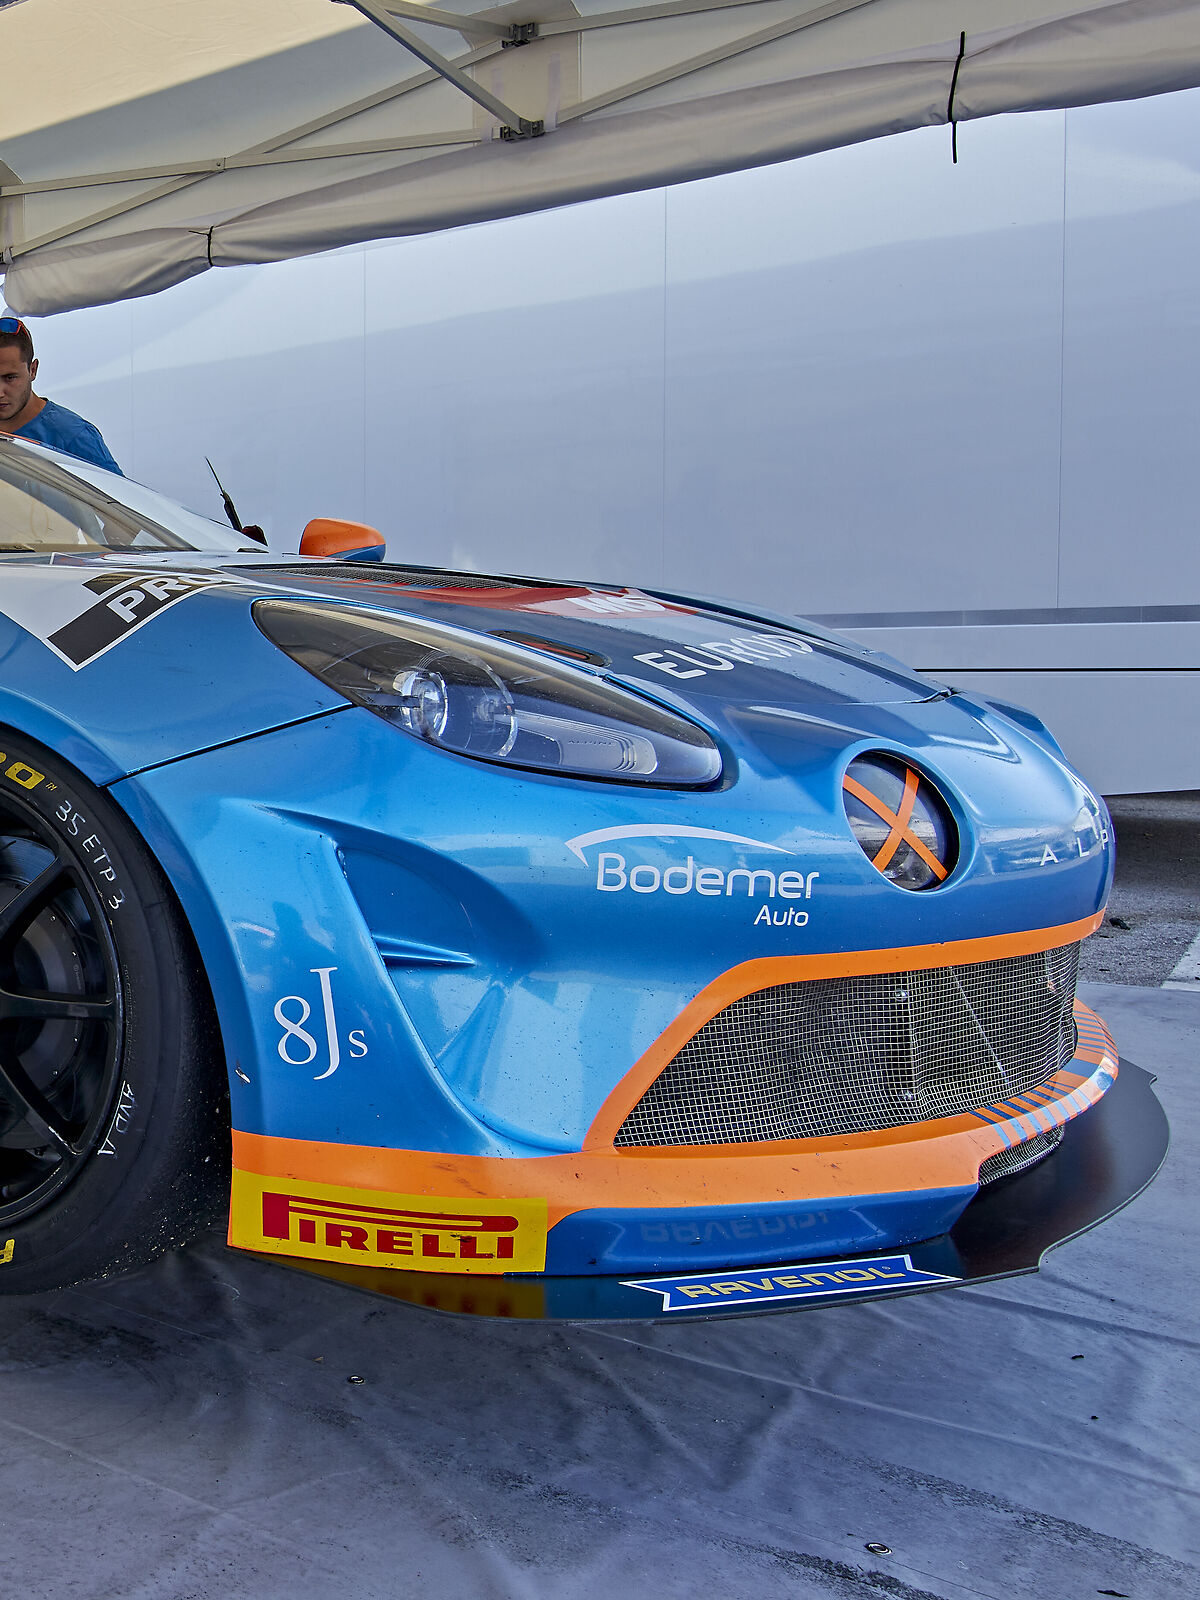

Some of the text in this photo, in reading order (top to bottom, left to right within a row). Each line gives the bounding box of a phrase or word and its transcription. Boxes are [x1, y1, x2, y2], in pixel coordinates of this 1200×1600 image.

[633, 634, 824, 680] EUROD
[55, 799, 86, 836] 35
[596, 852, 820, 899] Bodemer
[753, 904, 809, 927] Auto
[273, 966, 369, 1080] 8Js
[261, 1191, 519, 1259] PIRELLI
[675, 1265, 906, 1299] RAVENOL
